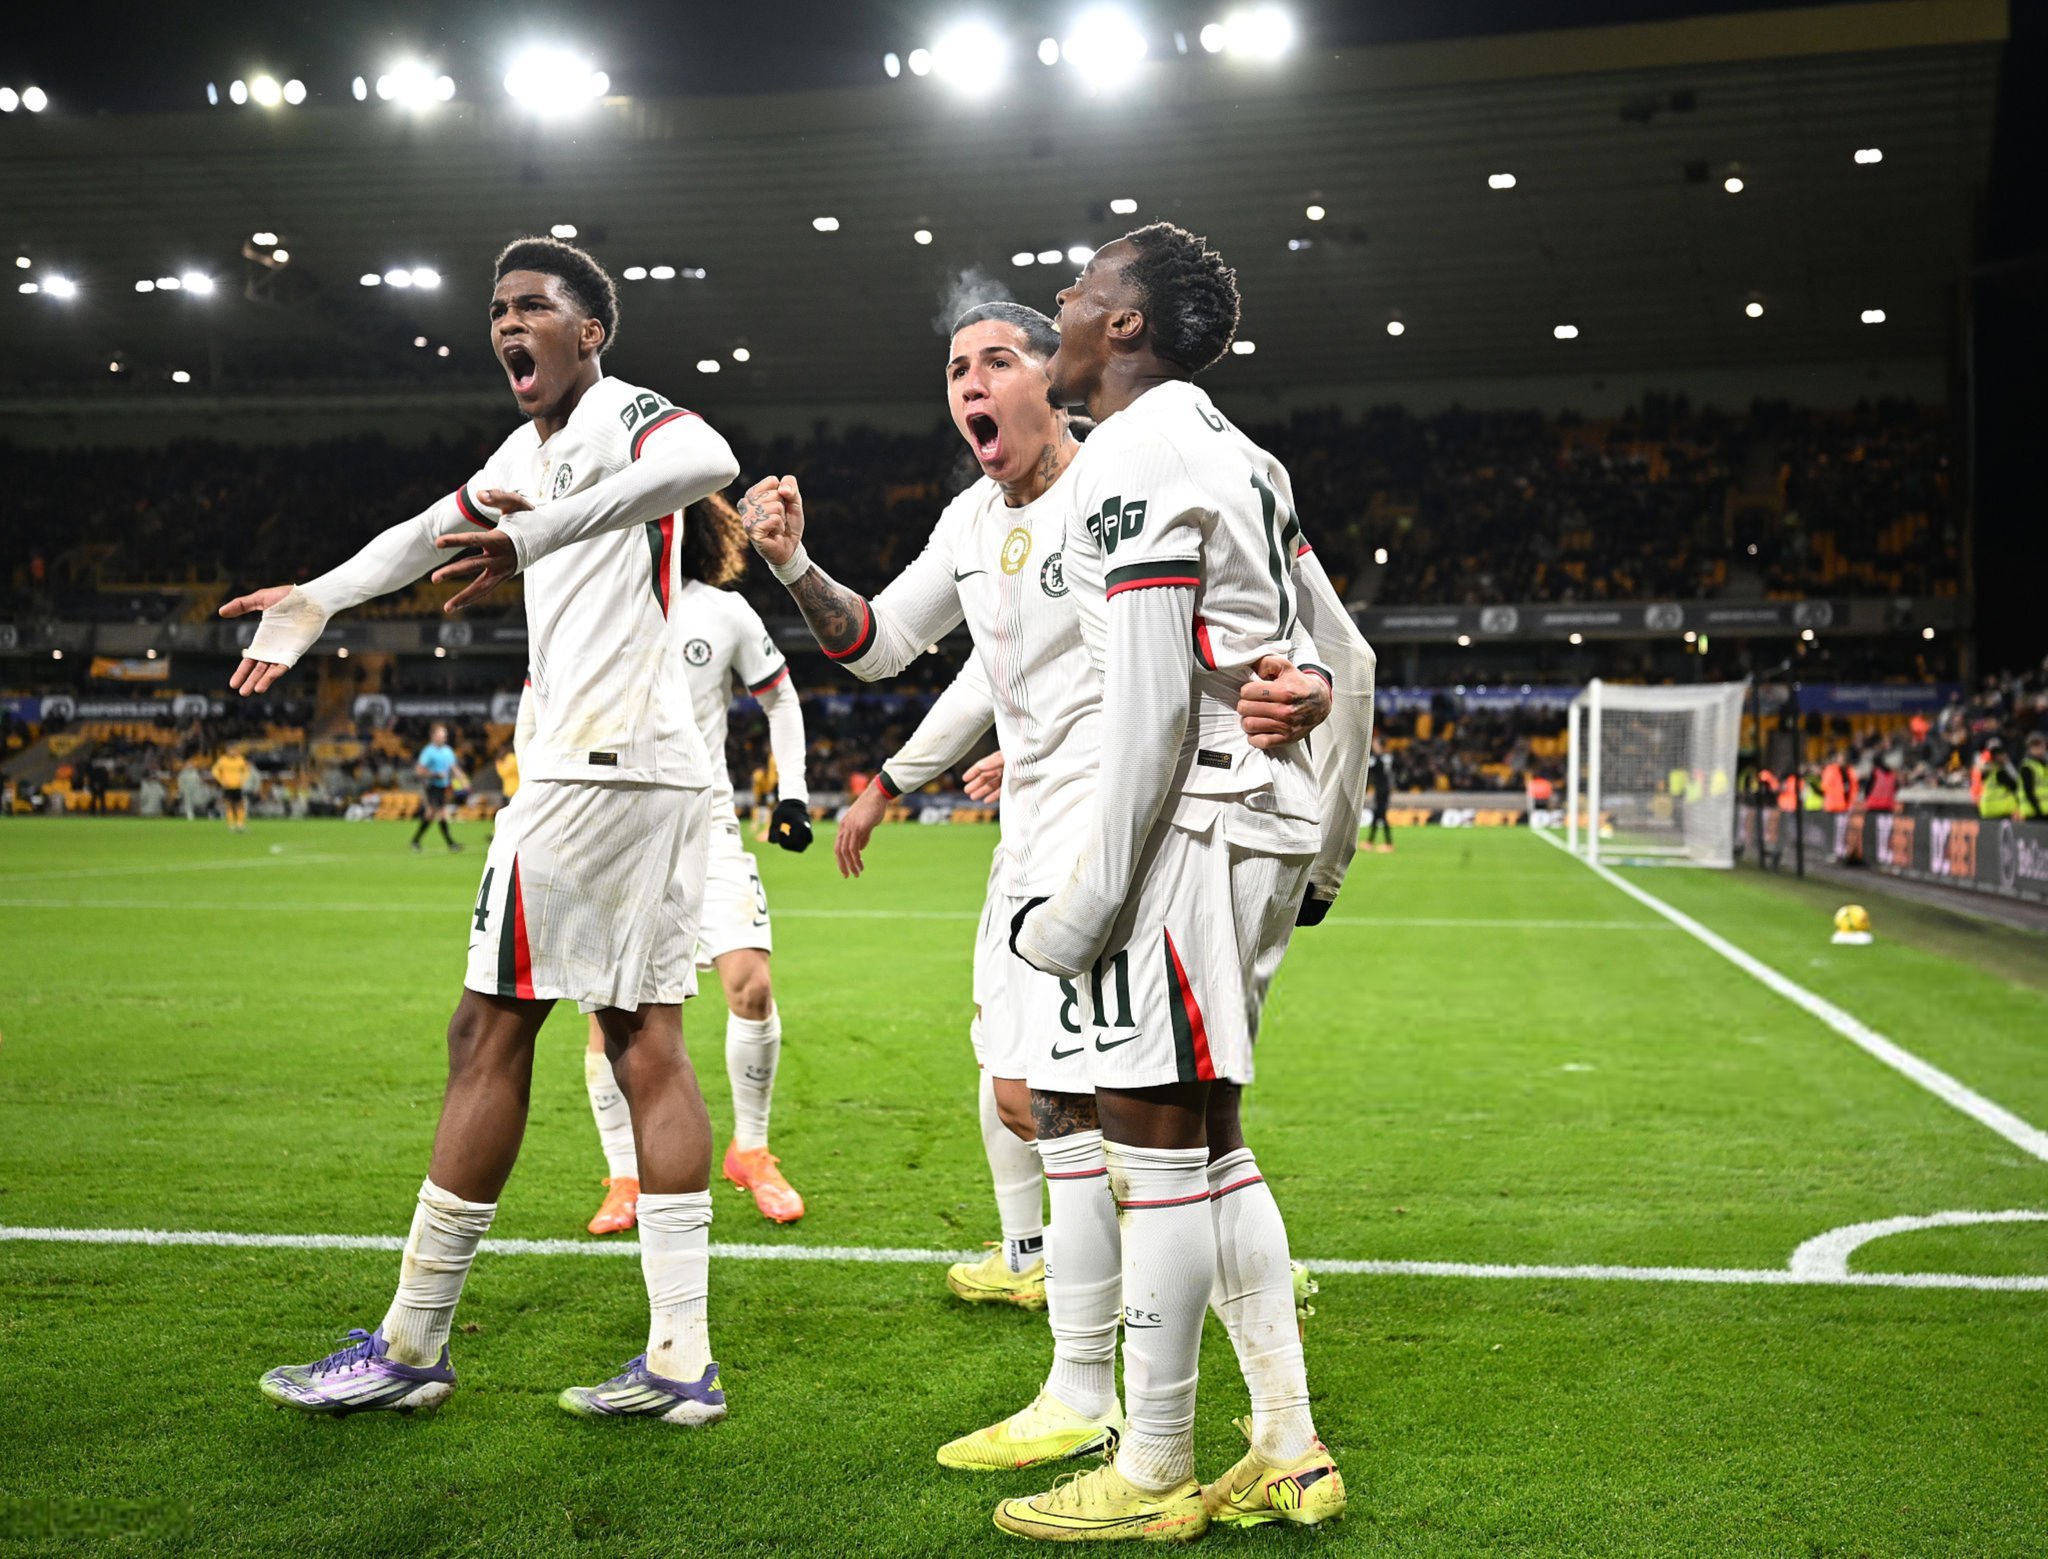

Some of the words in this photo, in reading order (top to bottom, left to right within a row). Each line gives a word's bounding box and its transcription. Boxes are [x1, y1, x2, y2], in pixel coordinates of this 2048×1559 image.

[1086, 495, 1147, 555] FPT
[474, 867, 495, 932] 4
[1092, 950, 1136, 1027] 11
[1125, 1306, 1162, 1323] CFC
